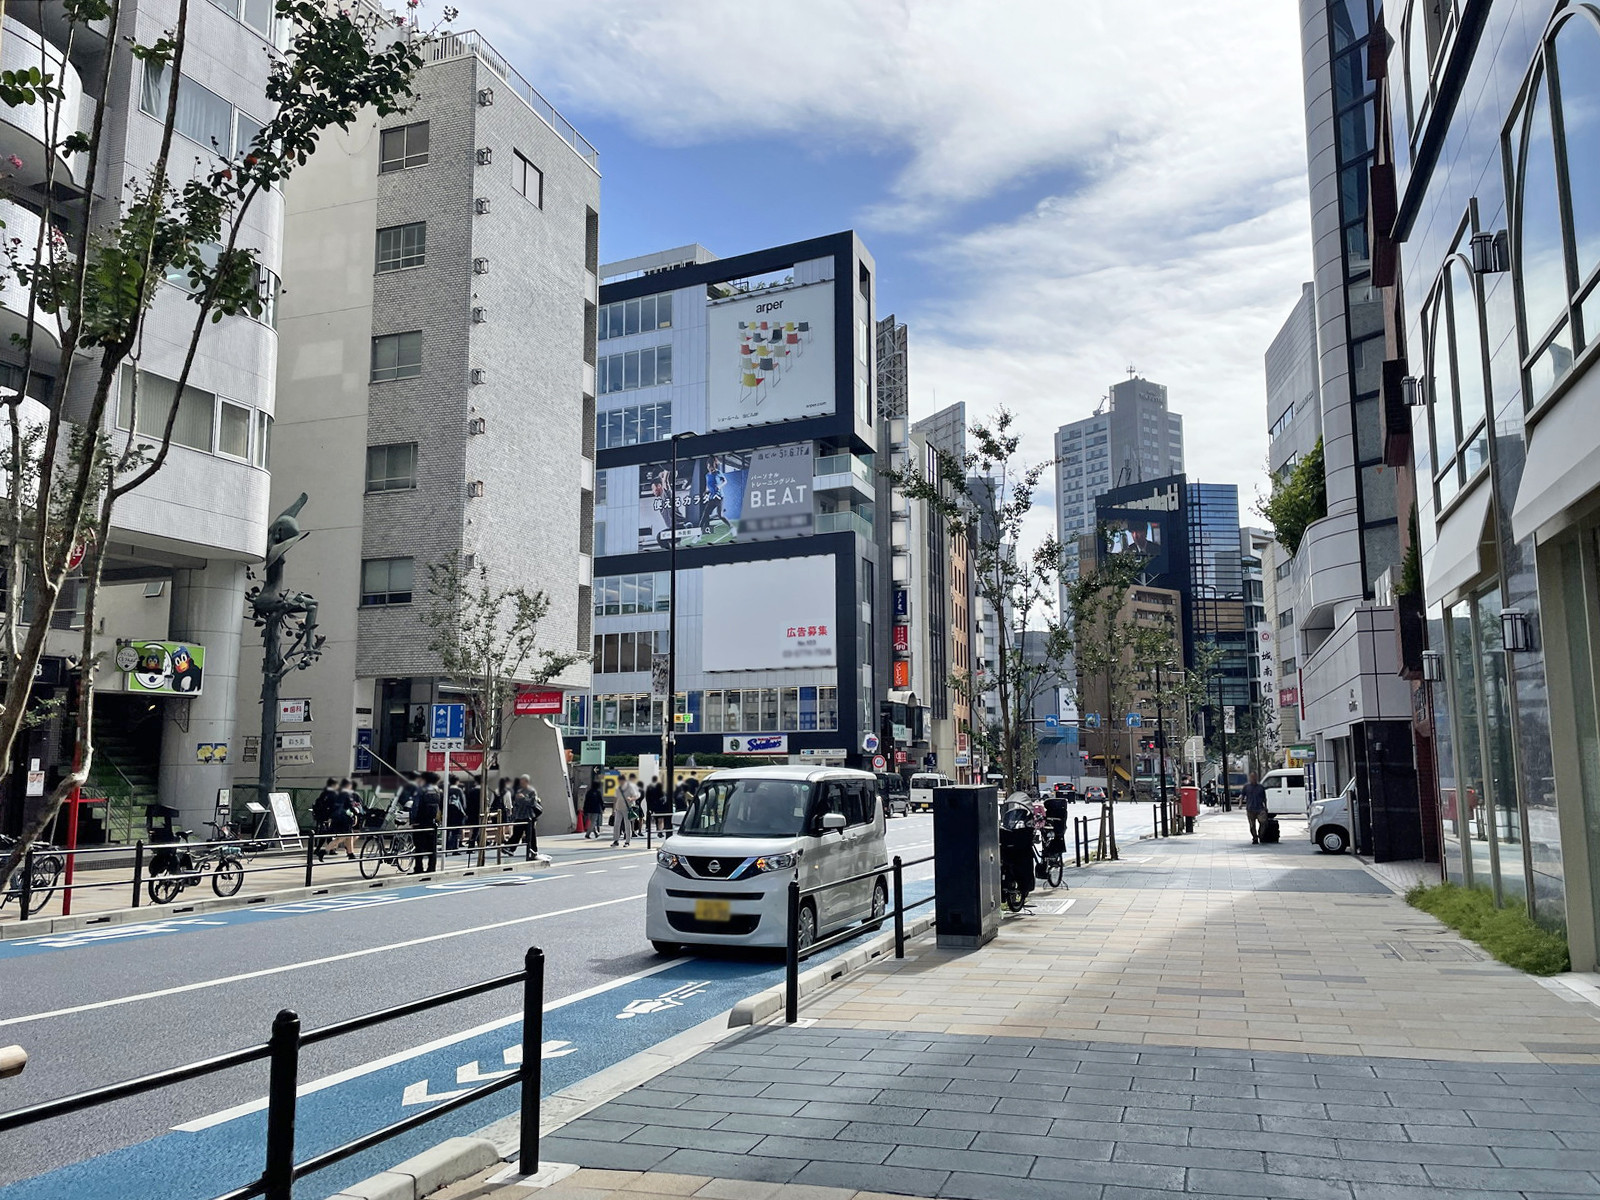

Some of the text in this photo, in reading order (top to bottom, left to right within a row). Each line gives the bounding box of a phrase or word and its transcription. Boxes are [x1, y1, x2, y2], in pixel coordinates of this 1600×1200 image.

[755, 300, 784, 314] arper
[750, 472, 779, 480] パーソナル
[751, 477, 796, 488] トレーニングジム
[653, 493, 722, 511] 使えるカラダへ
[750, 485, 807, 508] B.E.A.T
[786, 625, 828, 638] 広告募集
[431, 742, 462, 750] ここまで
[604, 778, 616, 793] P
